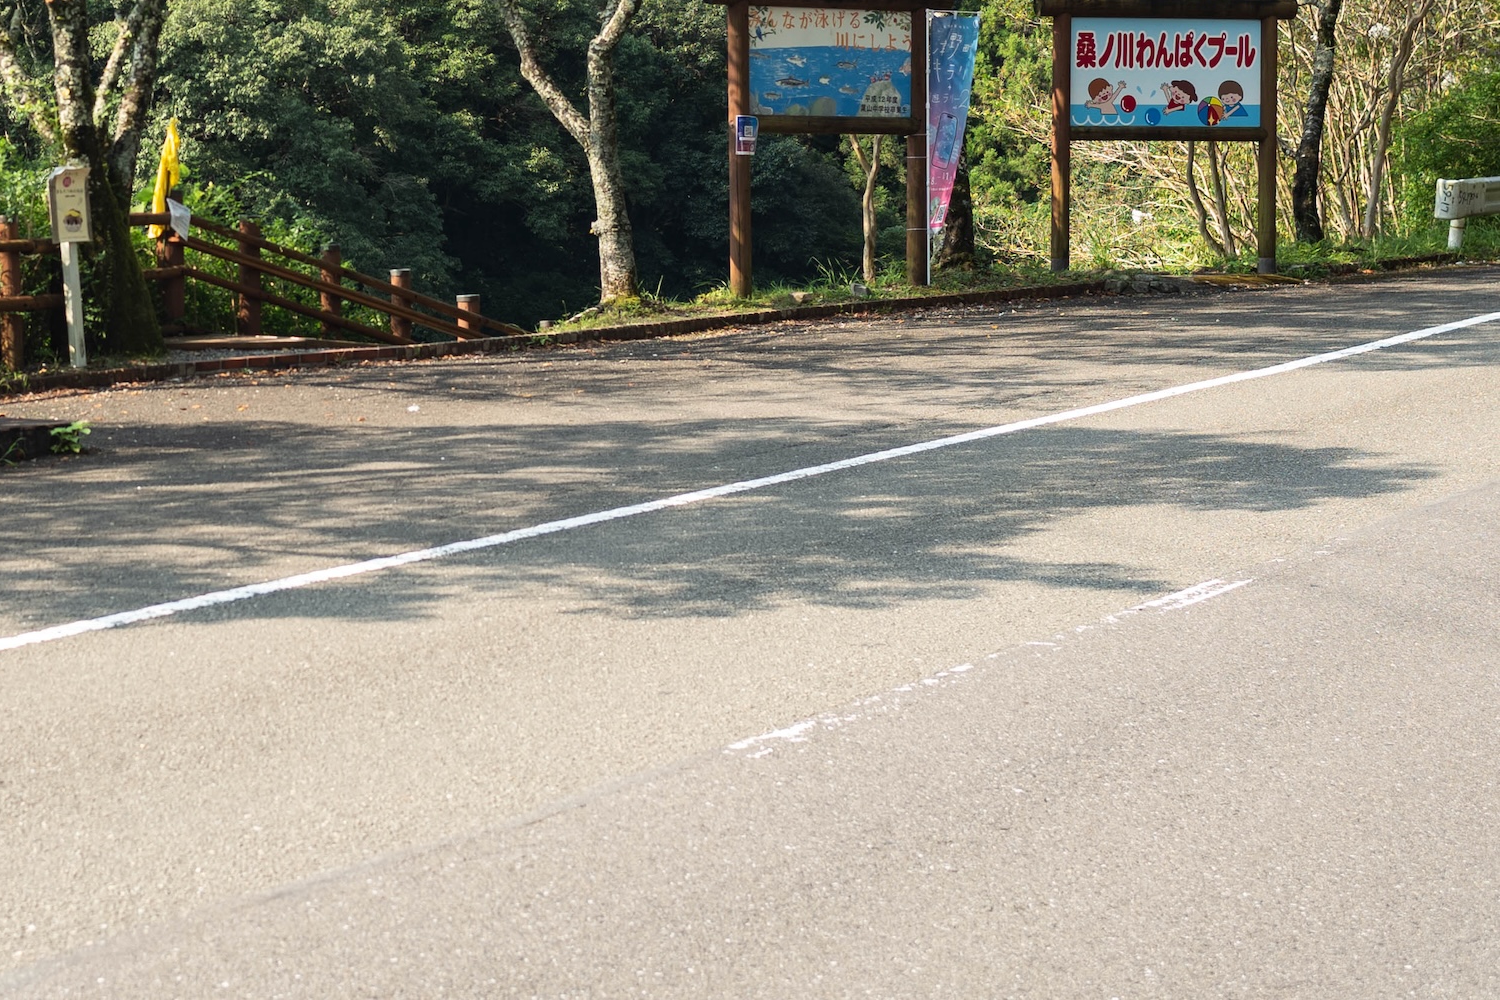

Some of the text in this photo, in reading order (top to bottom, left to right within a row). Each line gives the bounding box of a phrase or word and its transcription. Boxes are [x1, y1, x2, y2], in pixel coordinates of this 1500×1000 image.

[748, 9, 861, 30] みんなが泳げる
[836, 31, 912, 52] 川にしよう
[1076, 31, 1256, 69] 桑ノ川わんぱくプール
